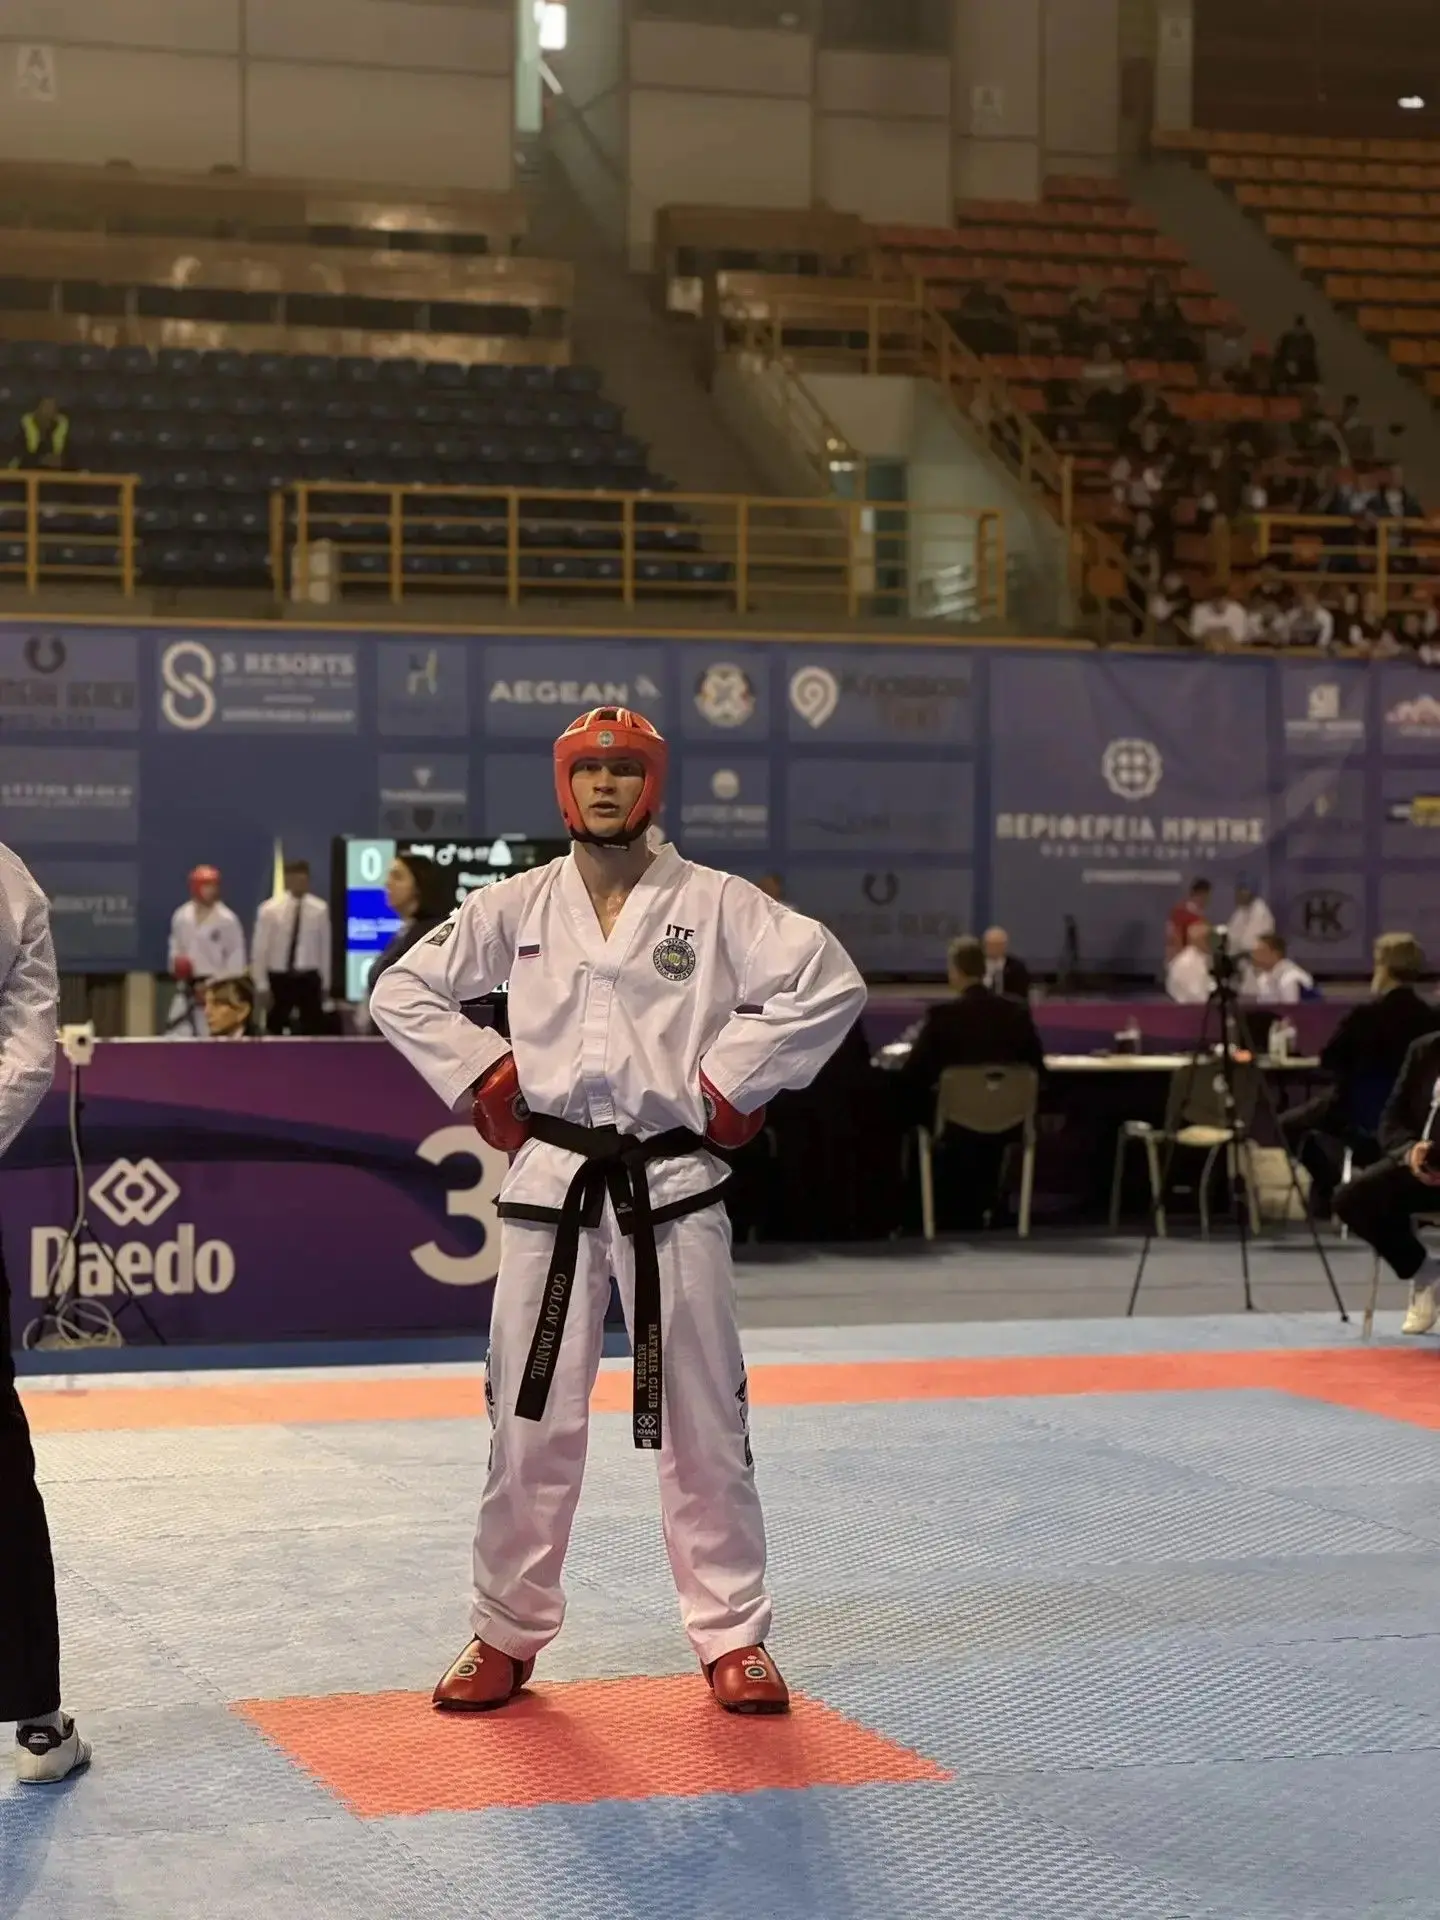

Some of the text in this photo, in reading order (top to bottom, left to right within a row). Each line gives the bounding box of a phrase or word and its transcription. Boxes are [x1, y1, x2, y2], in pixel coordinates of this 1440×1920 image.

[244, 653, 355, 675] RESORTS
[489, 680, 629, 705] AEGEAN
[360, 847, 383, 881] 0
[666, 924, 695, 940] ITF
[411, 1125, 510, 1286] 3
[30, 1224, 236, 1298] Daedo
[546, 1273, 567, 1326] GOLOV
[637, 1343, 647, 1389] RUSSIA
[648, 1377, 658, 1408] CLUB
